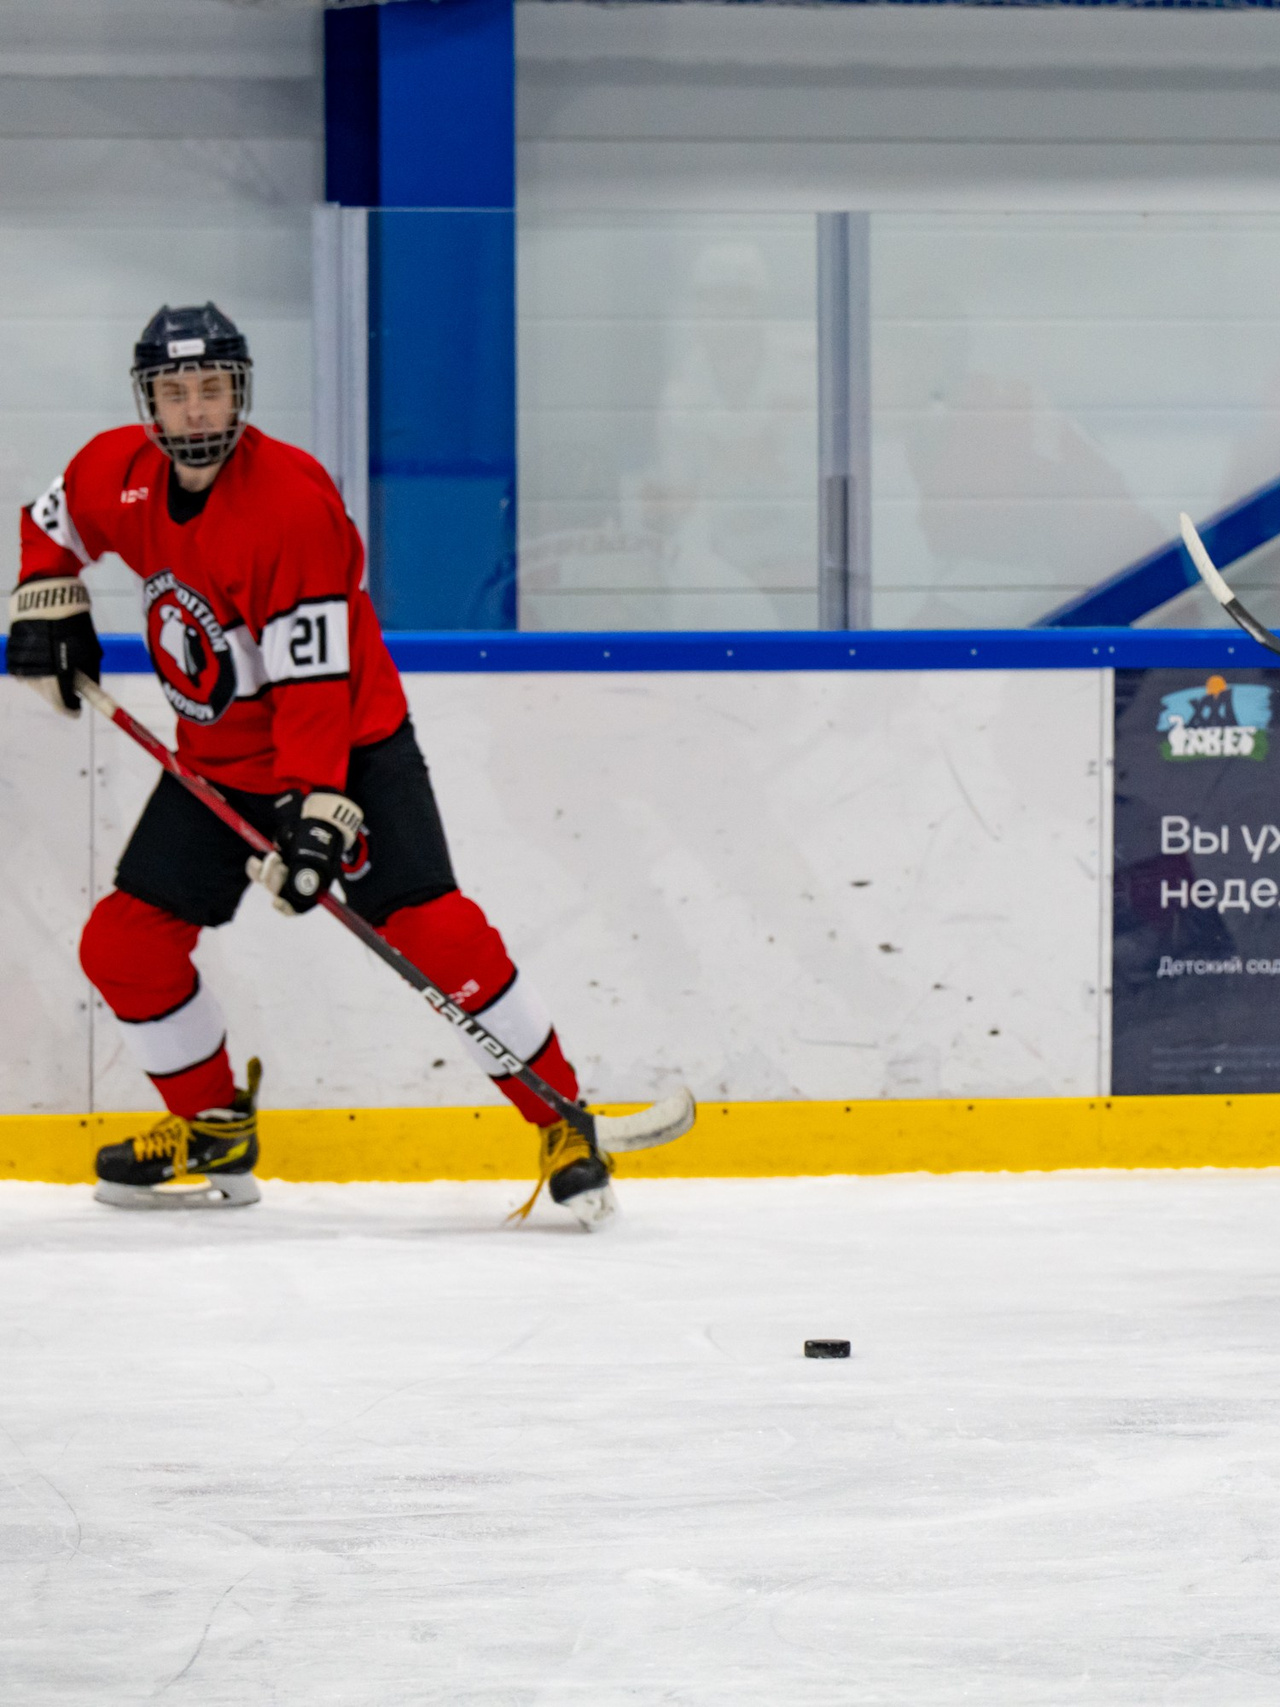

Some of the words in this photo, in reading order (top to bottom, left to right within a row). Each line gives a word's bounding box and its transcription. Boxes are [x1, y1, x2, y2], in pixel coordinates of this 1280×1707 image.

[289, 614, 329, 666] 21
[1161, 815, 1229, 856] Вы
[1157, 955, 1243, 978] Детский
